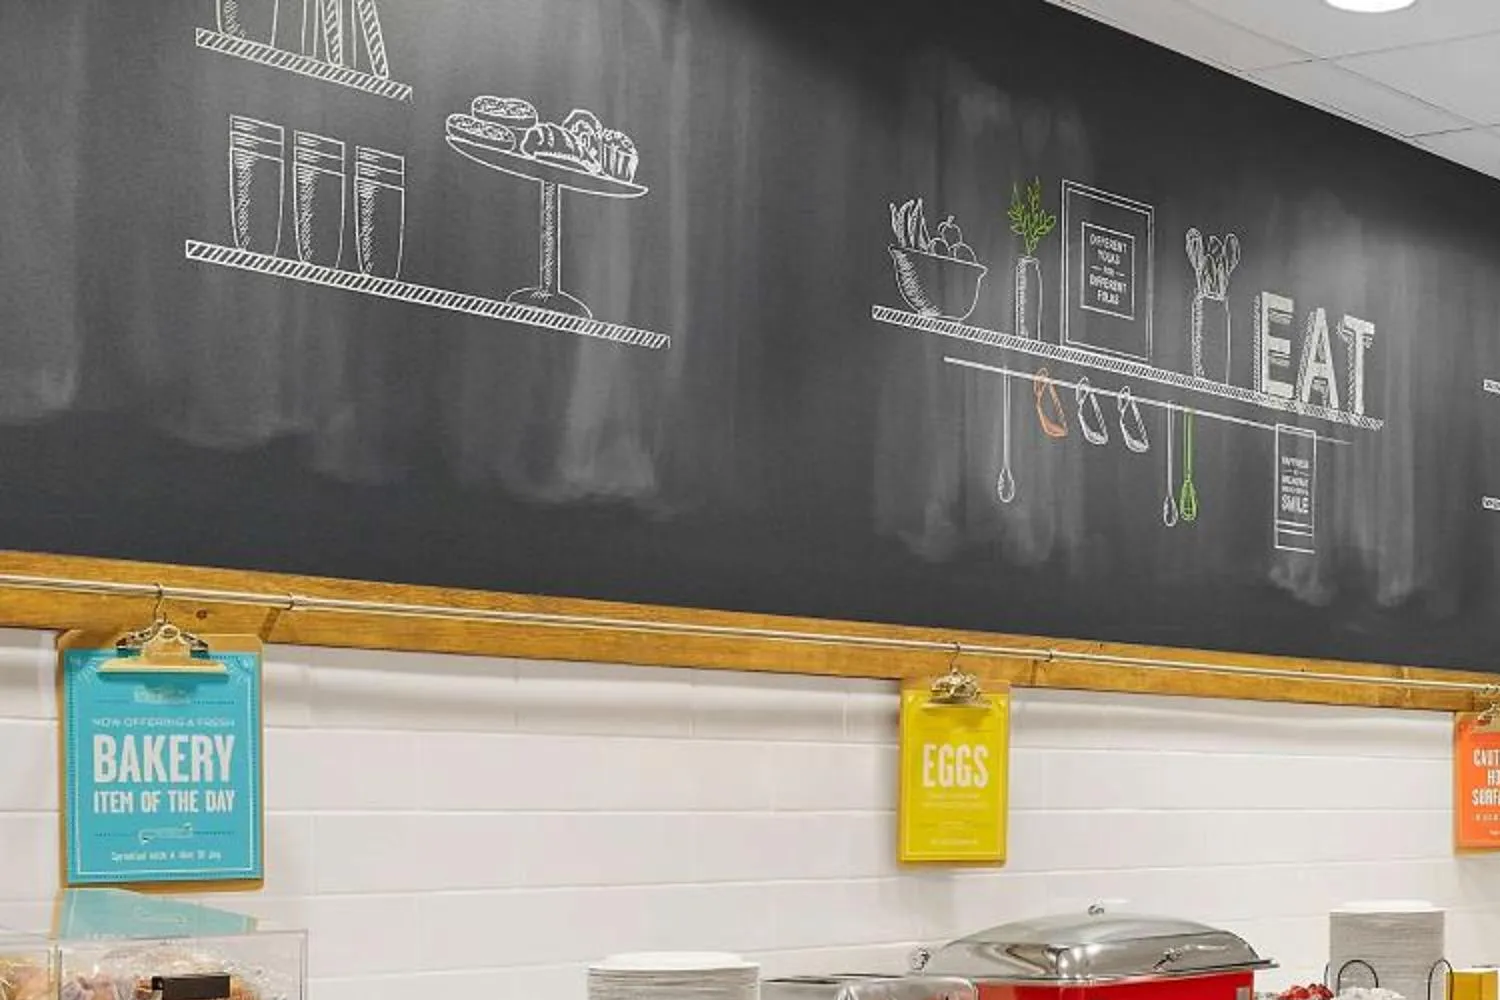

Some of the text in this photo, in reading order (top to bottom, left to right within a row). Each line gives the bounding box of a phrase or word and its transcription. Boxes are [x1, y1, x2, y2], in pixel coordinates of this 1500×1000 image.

[1089, 233, 1128, 254] DIFFERENT
[1089, 273, 1128, 294] DIFFERENT
[1253, 291, 1376, 416] EAT
[1281, 494, 1309, 513] SMILE
[92, 734, 236, 784] BAKERY
[923, 743, 989, 788] EGGS
[93, 789, 236, 814] ITEM OF THE DAY
